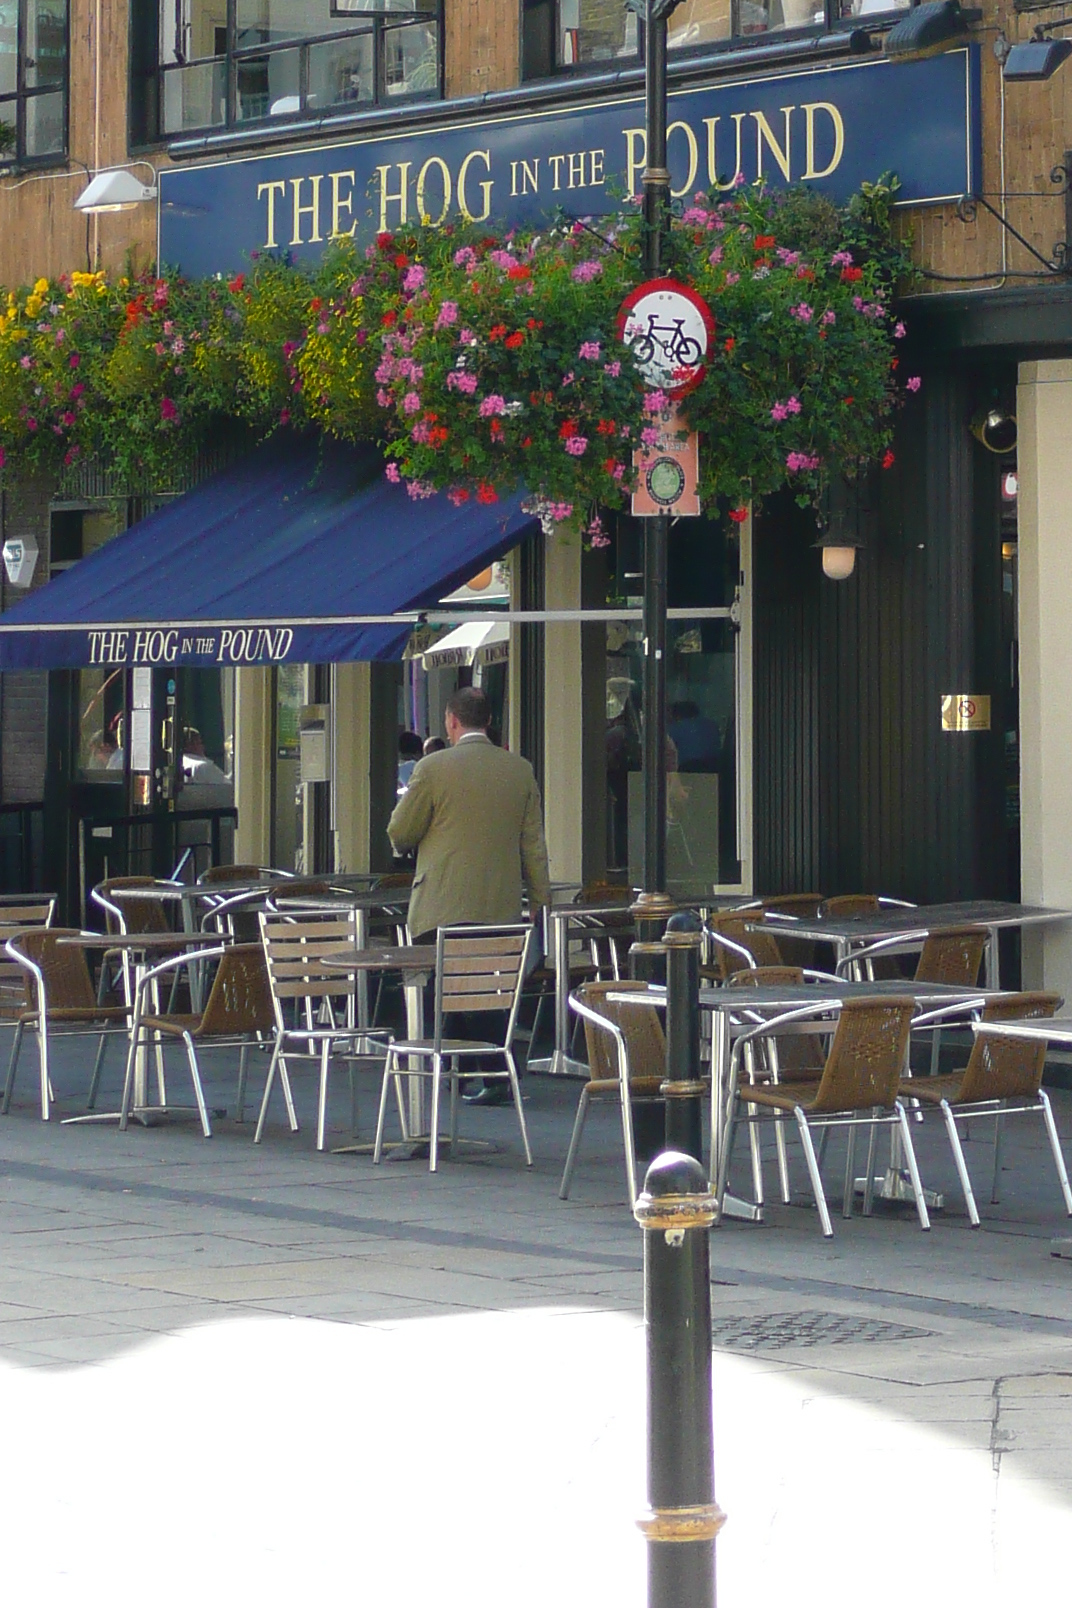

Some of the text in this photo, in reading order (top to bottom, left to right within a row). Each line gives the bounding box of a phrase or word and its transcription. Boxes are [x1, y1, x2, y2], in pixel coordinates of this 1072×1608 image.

[257, 102, 846, 249] THE HOG IN THE POUND
[88, 628, 295, 665] THE HOG IN THE POUND
